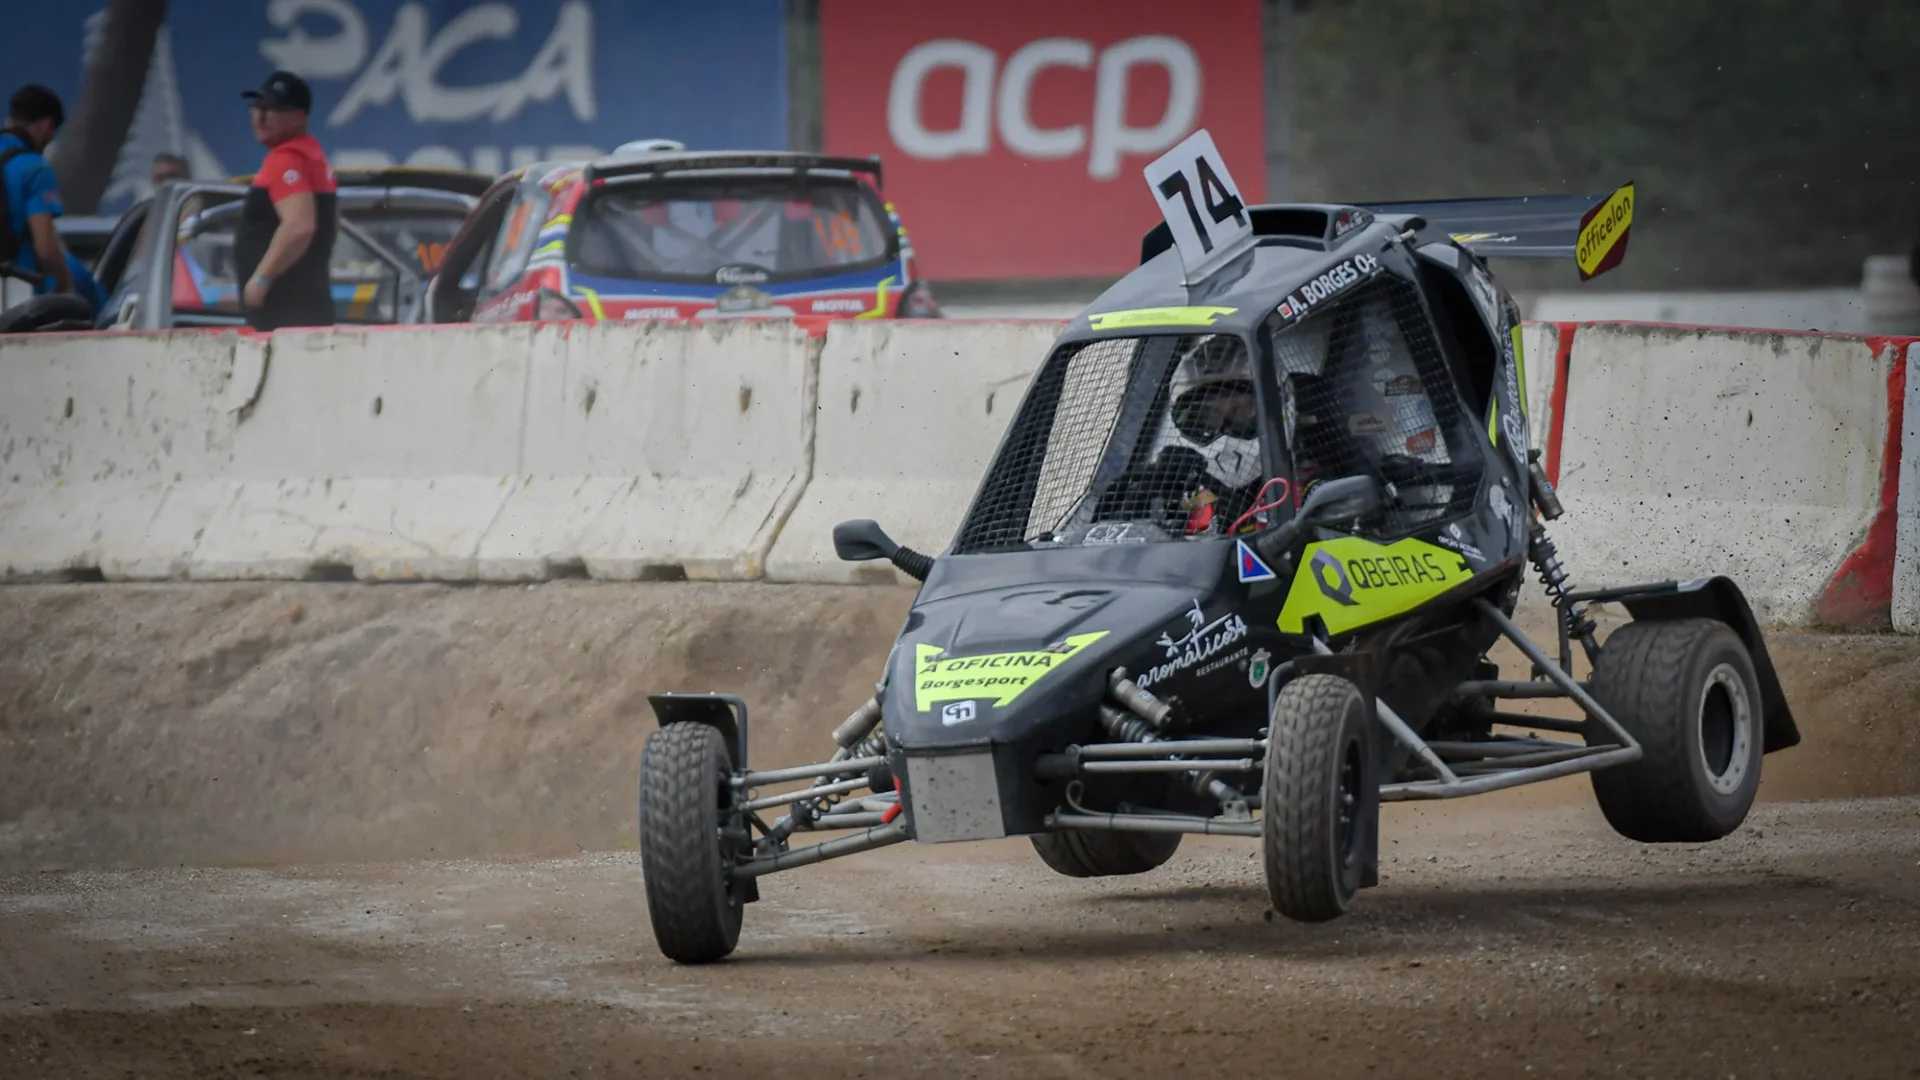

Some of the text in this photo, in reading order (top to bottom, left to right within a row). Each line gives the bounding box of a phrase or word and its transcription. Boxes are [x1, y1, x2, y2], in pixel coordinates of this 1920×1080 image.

[887, 34, 1204, 179] acp
[1157, 154, 1248, 255] 74
[1579, 195, 1632, 265] officelan
[1286, 294, 1309, 315] A.
[1300, 260, 1359, 306] BORGES
[1347, 553, 1446, 590] QBEIRAS
[919, 655, 1052, 675] A OFICINA
[920, 675, 1028, 690] Borgesport
[1195, 646, 1249, 677] RESTAURANTE
